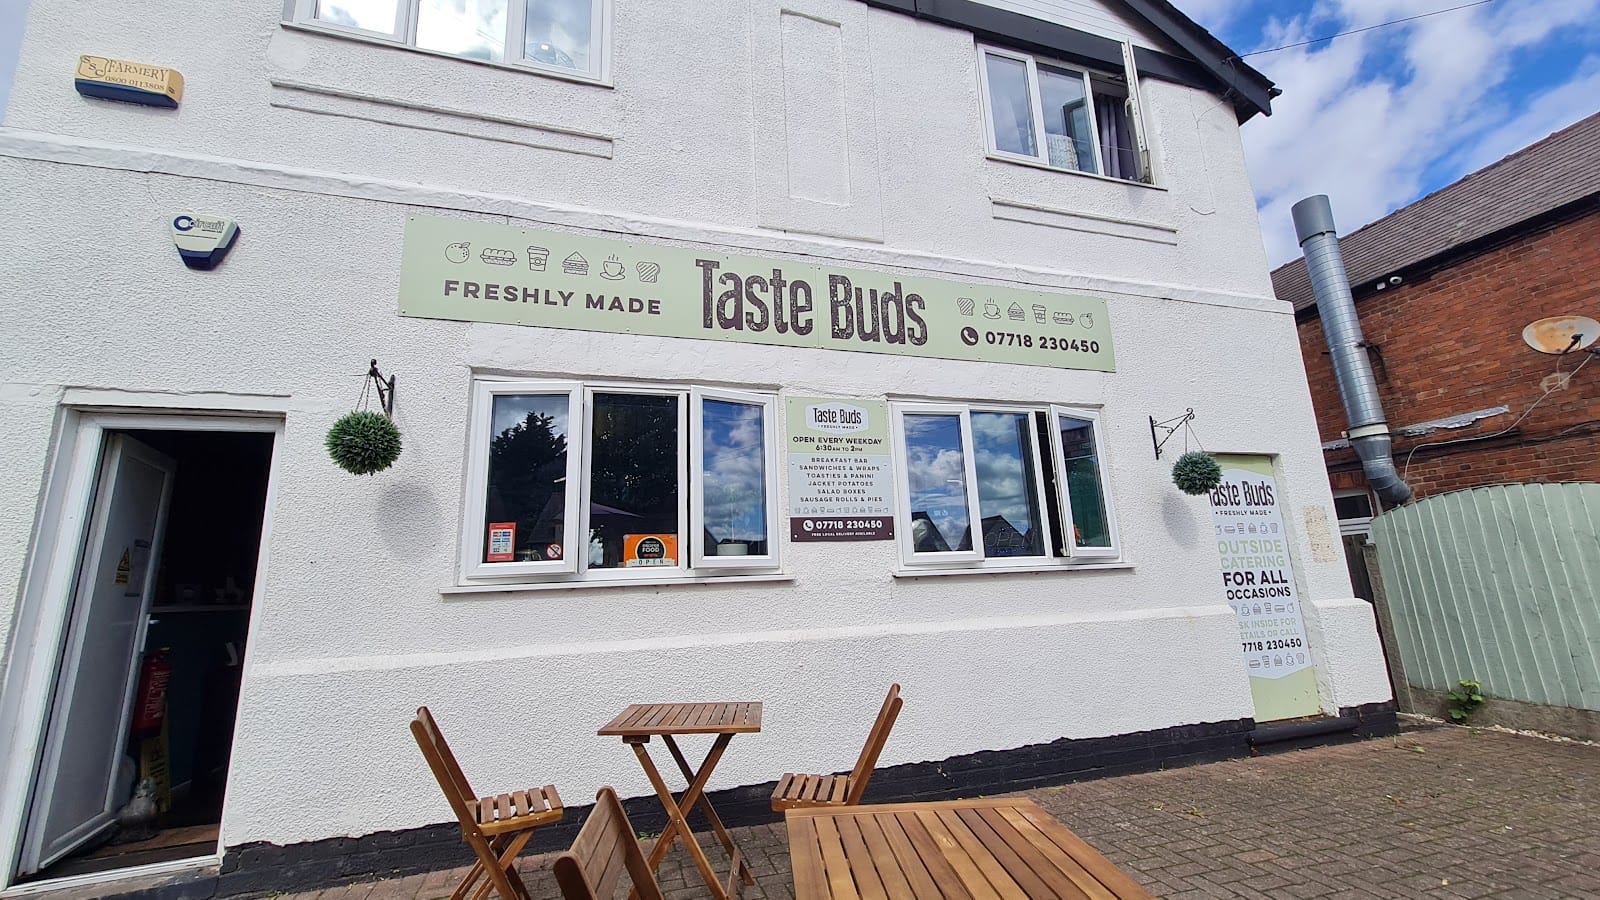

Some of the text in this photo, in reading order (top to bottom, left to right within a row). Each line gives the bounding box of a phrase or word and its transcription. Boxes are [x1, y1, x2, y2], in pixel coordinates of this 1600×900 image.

[107, 60, 168, 82] FARMERY
[444, 279, 661, 315] FRESHLY MADE
[695, 259, 928, 346] Taste Buds
[985, 331, 1100, 354] 07718 230450
[813, 408, 862, 425] Taste Buds
[1242, 480, 1275, 507] Buds
[815, 519, 883, 529] 07718 230450
[1218, 540, 1284, 554] OUTSIDE
[1220, 555, 1285, 570] CATERING
[1222, 569, 1289, 587] FOR ALL
[1226, 586, 1292, 601] OCCASIONS
[1251, 618, 1279, 629] INSIDE
[1281, 617, 1297, 627] FOR
[1267, 629, 1278, 638] OR
[1280, 628, 1299, 637] CALL
[1266, 638, 1302, 651] 230450
